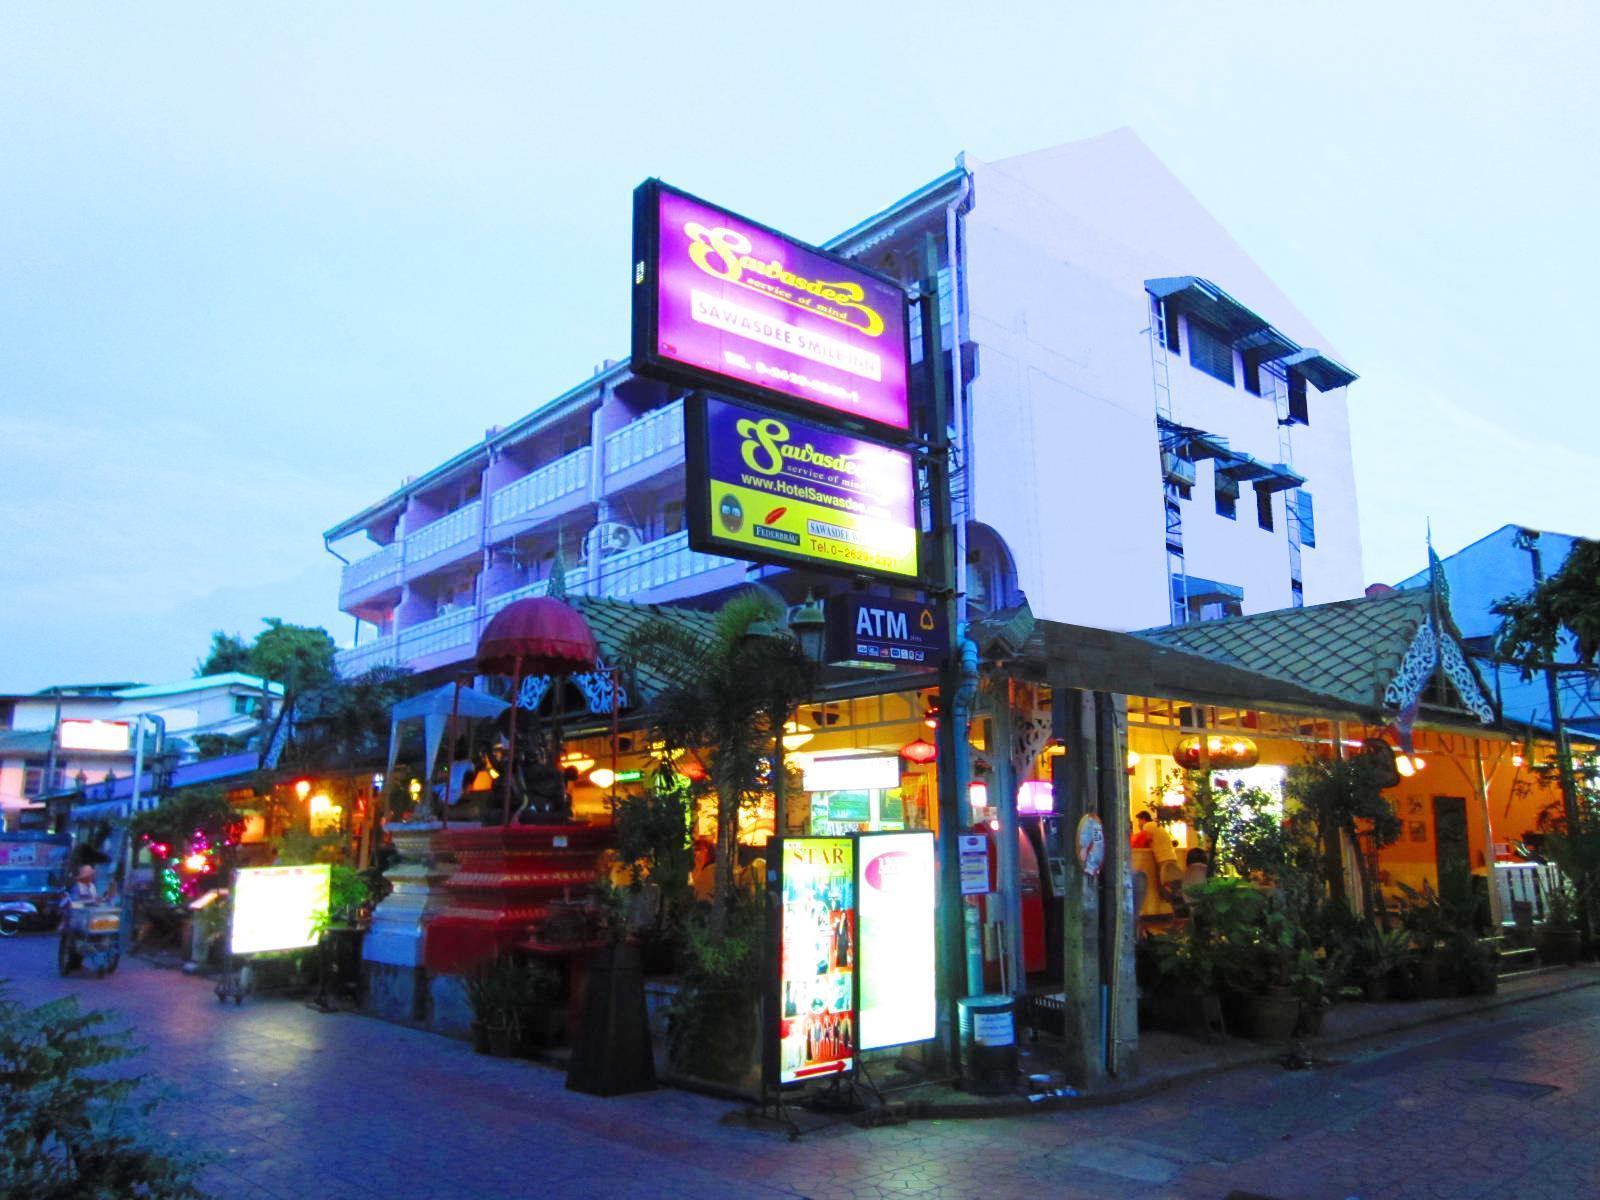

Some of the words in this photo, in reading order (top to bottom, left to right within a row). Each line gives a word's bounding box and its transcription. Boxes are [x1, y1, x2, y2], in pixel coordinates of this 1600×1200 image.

[747, 277, 792, 299] service
[797, 296, 811, 306] of
[816, 302, 848, 320] mind
[699, 301, 792, 345] SAWASDEE
[736, 418, 868, 476] Sawasde
[787, 465, 825, 480] service
[828, 474, 838, 483] of
[856, 607, 908, 640] ATM
